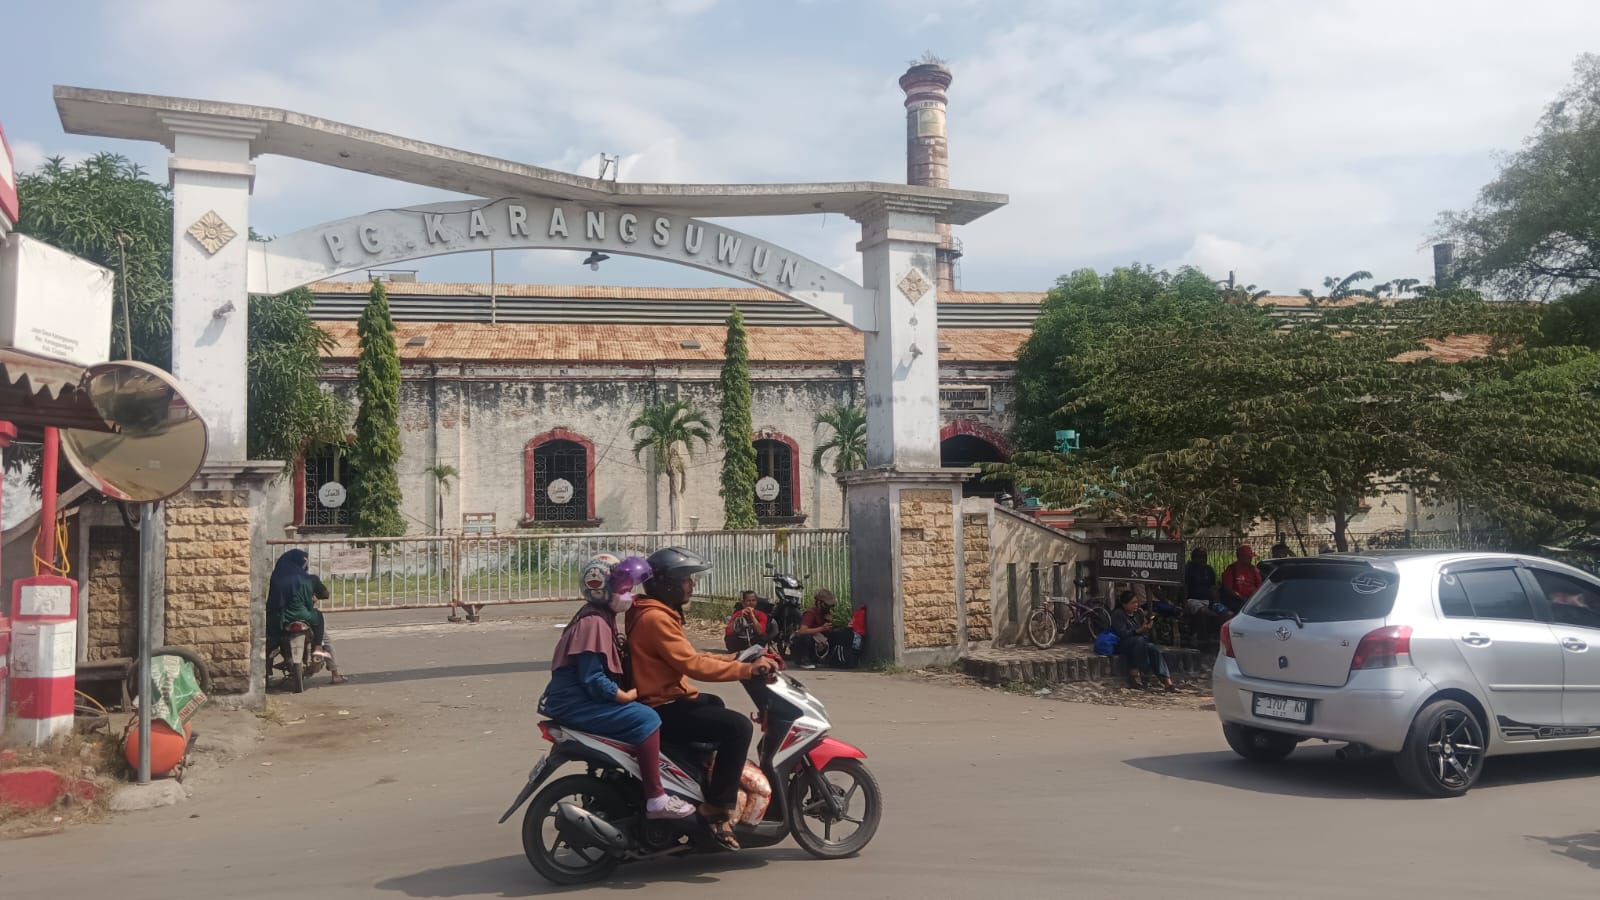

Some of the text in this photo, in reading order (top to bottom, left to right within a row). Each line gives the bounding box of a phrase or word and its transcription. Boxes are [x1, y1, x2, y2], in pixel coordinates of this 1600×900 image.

[423, 204, 801, 289] KARANGSUWUN
[1104, 550, 1178, 561] DILARANG MENJEMPUT
